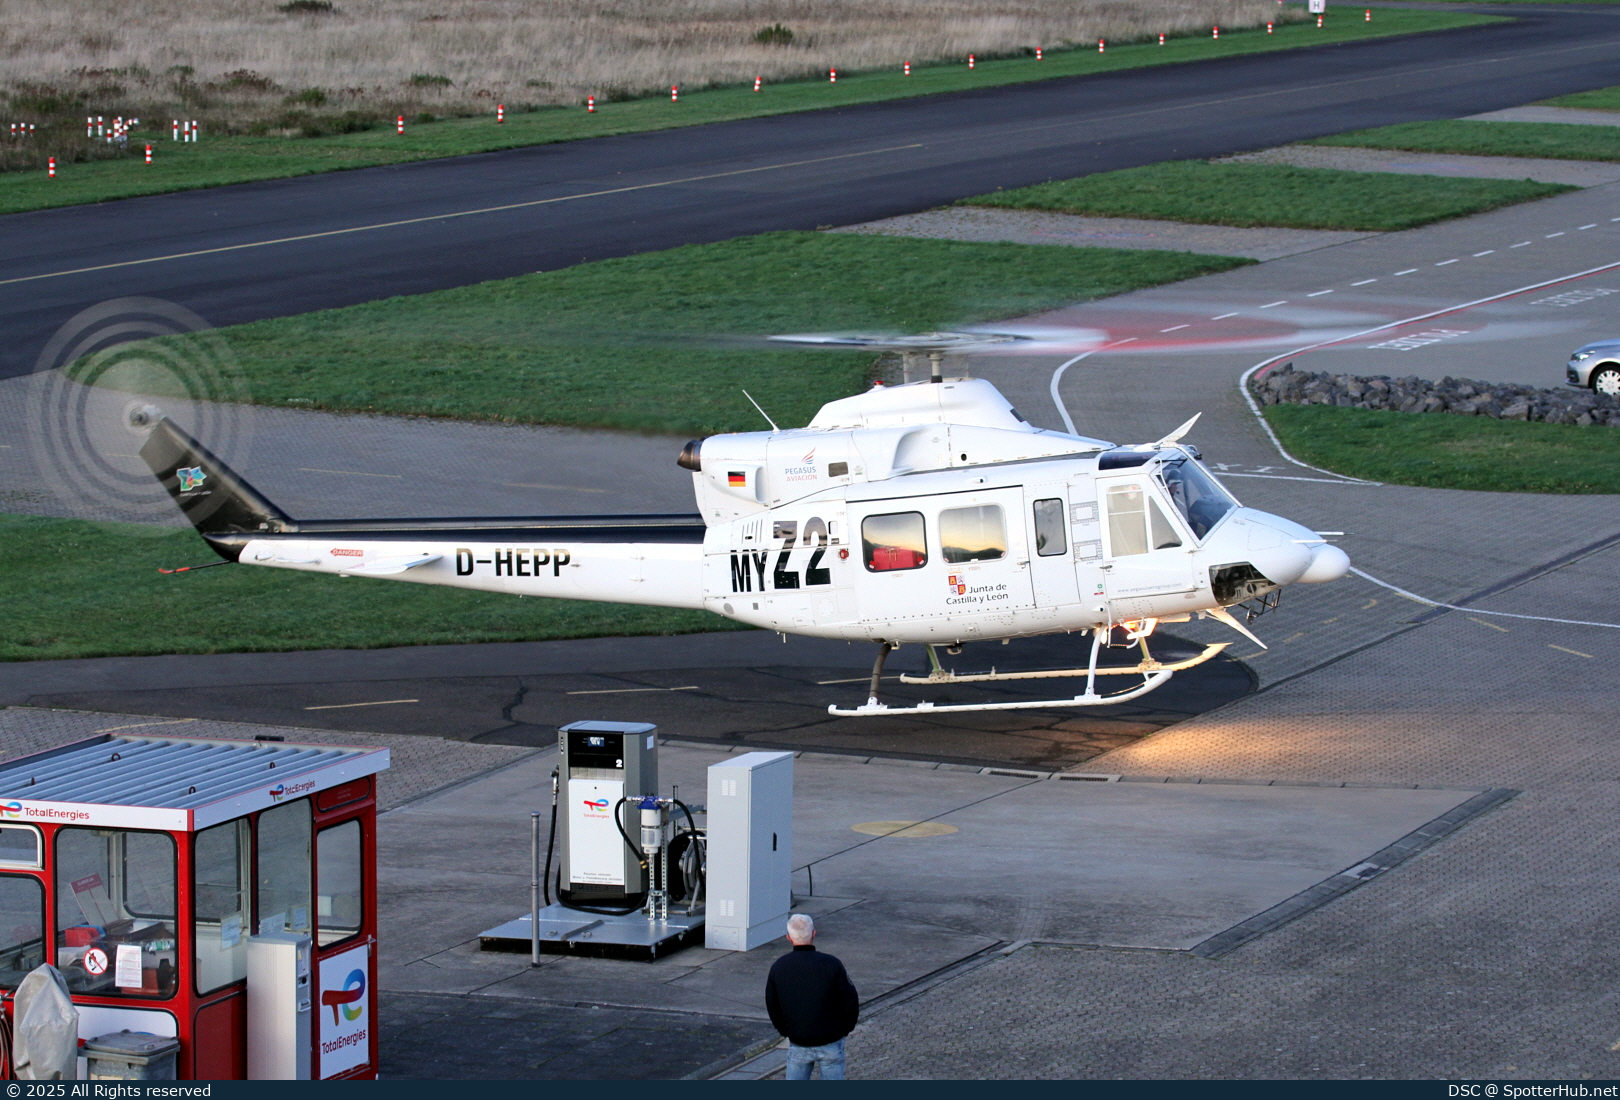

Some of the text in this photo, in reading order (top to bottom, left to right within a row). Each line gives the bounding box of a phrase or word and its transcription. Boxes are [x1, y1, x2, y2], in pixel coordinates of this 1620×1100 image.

[785, 466, 817, 475] PEGASUS
[456, 548, 571, 577] D-HEPP
[969, 583, 1007, 594] Junta de
[946, 593, 1009, 605] Castilla y León
[615, 758, 623, 768] 2
[284, 779, 316, 796] TotalEnergies
[24, 806, 90, 821] TotalEnergies
[322, 1028, 367, 1055] TotalEnergies
